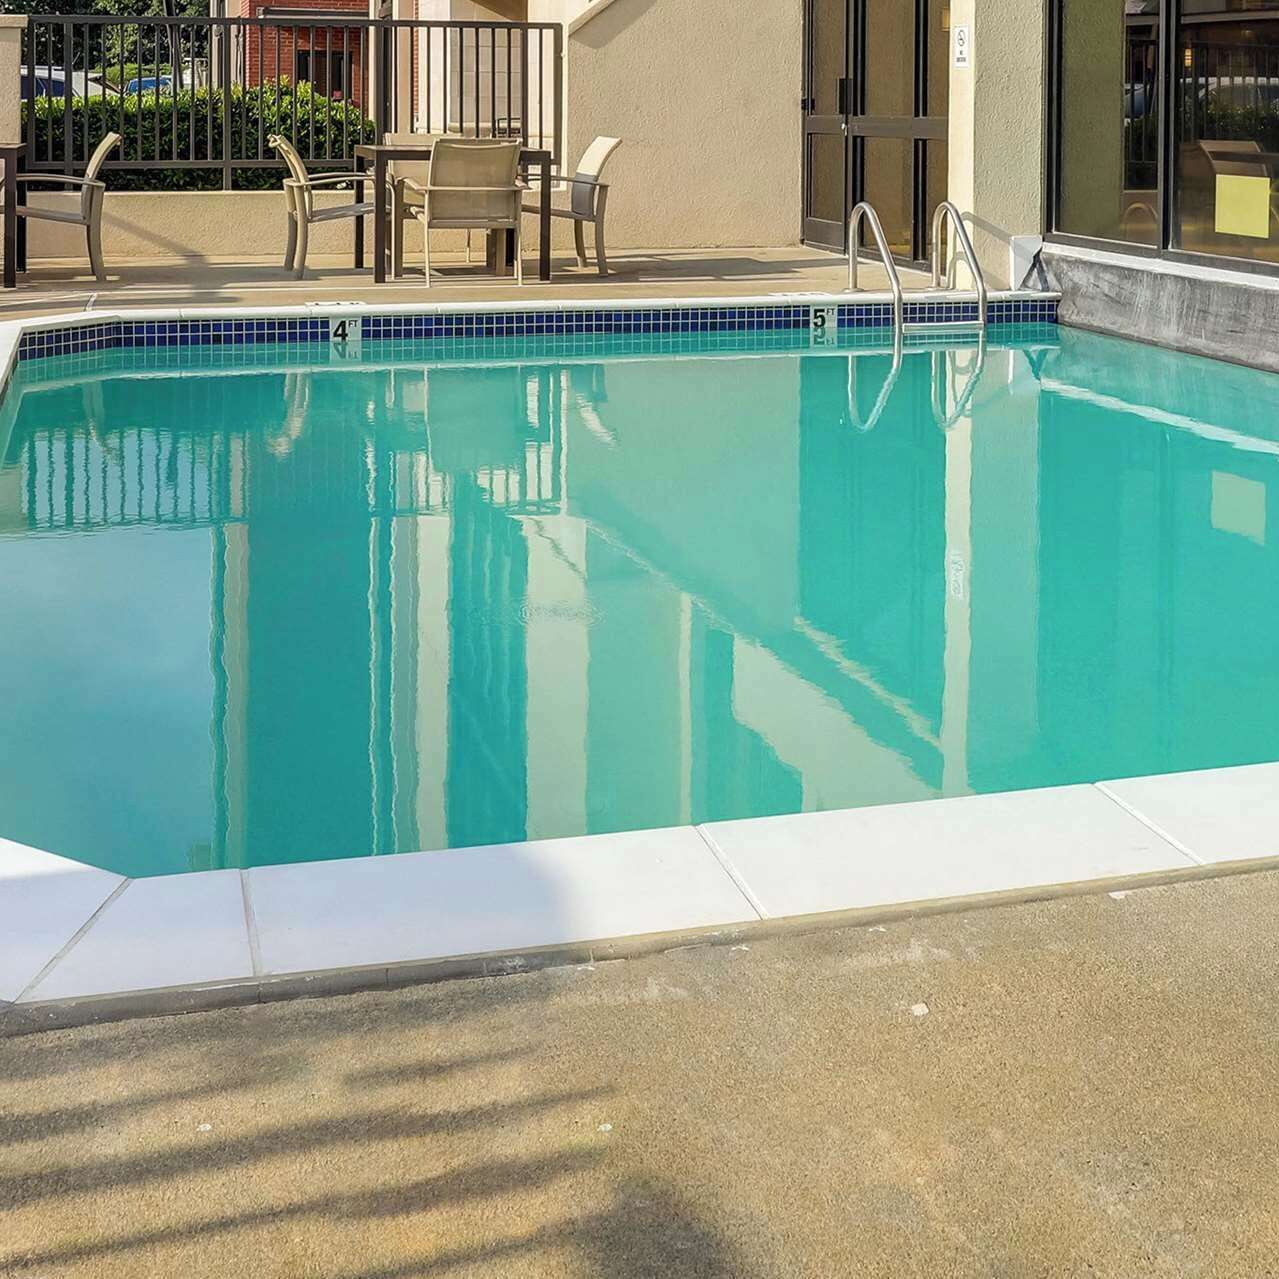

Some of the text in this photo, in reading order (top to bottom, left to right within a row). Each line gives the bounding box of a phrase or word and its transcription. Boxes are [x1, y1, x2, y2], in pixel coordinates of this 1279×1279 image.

[813, 308, 835, 328] 5 FT
[333, 320, 358, 341] 4 FT
